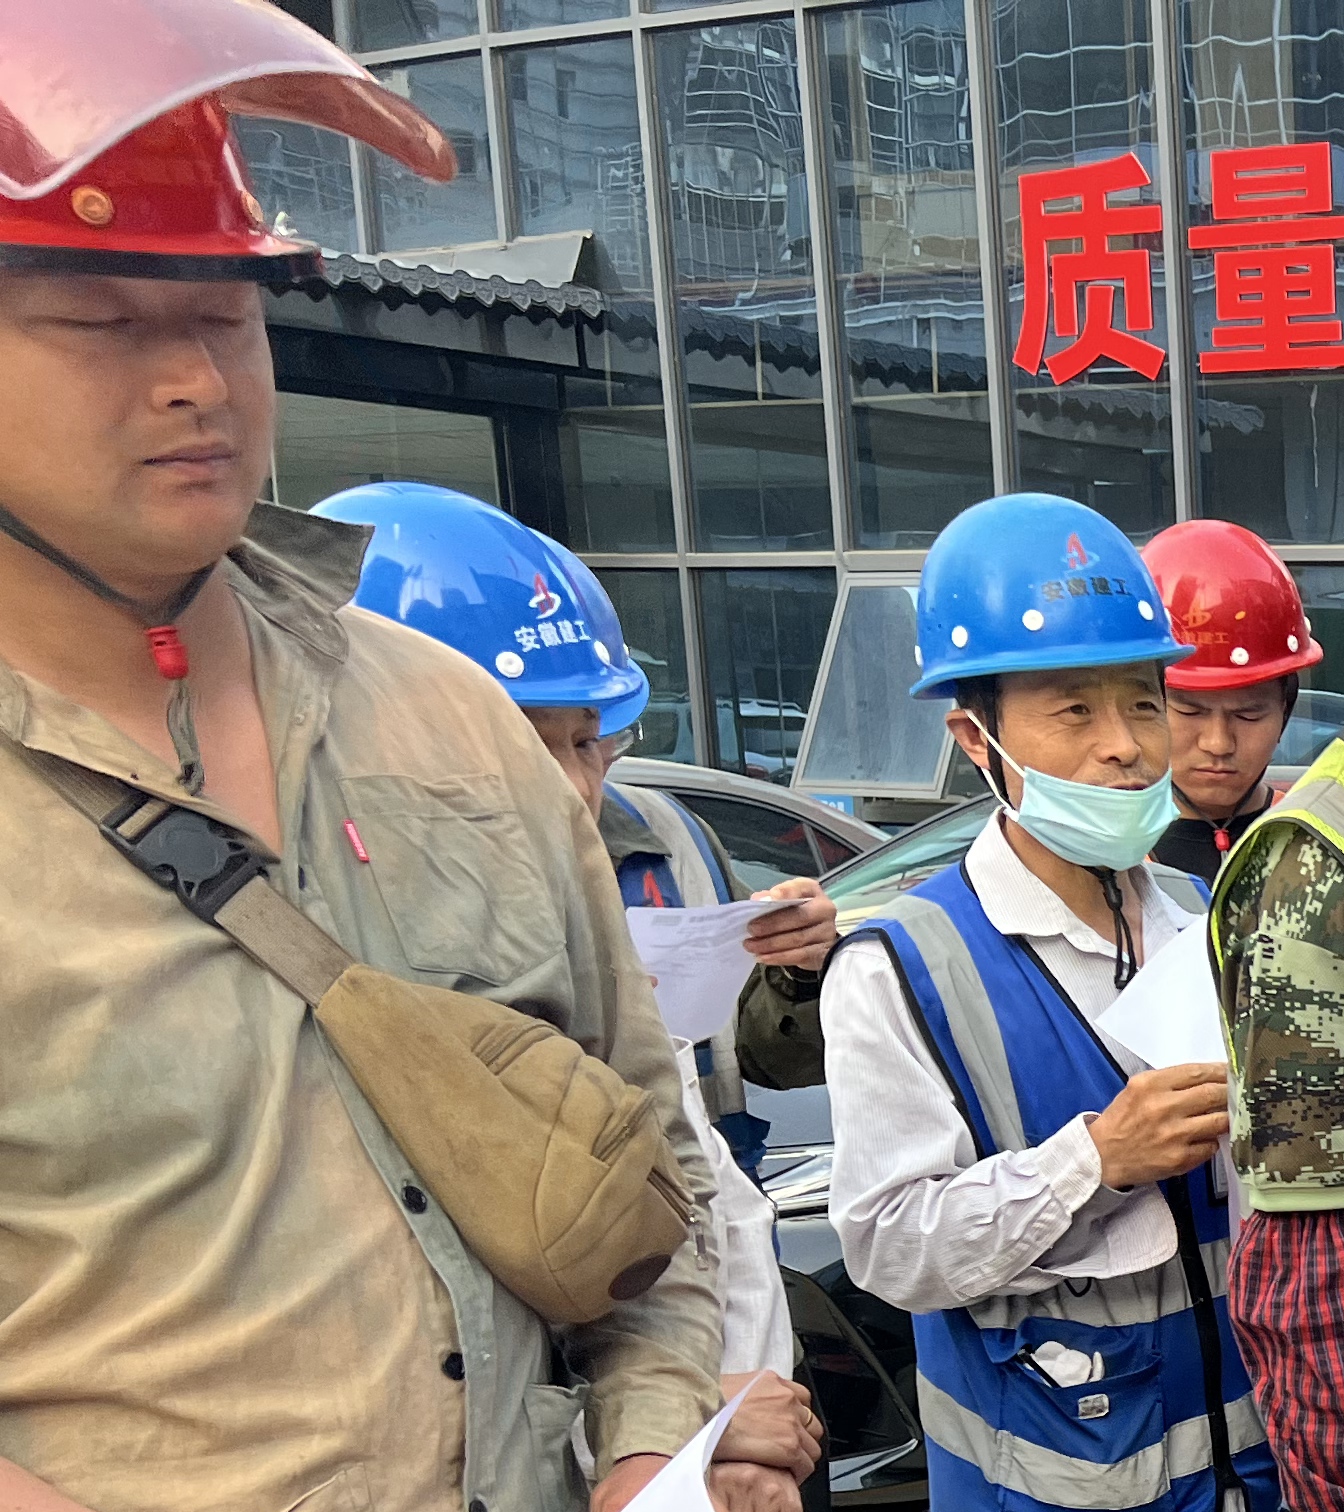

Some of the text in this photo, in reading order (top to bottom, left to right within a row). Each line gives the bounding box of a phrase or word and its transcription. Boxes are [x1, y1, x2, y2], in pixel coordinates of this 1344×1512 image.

[1041, 576, 1133, 602] 安徽建工
[514, 620, 592, 652] 安徽建工
[1181, 631, 1230, 646] 徽建工
